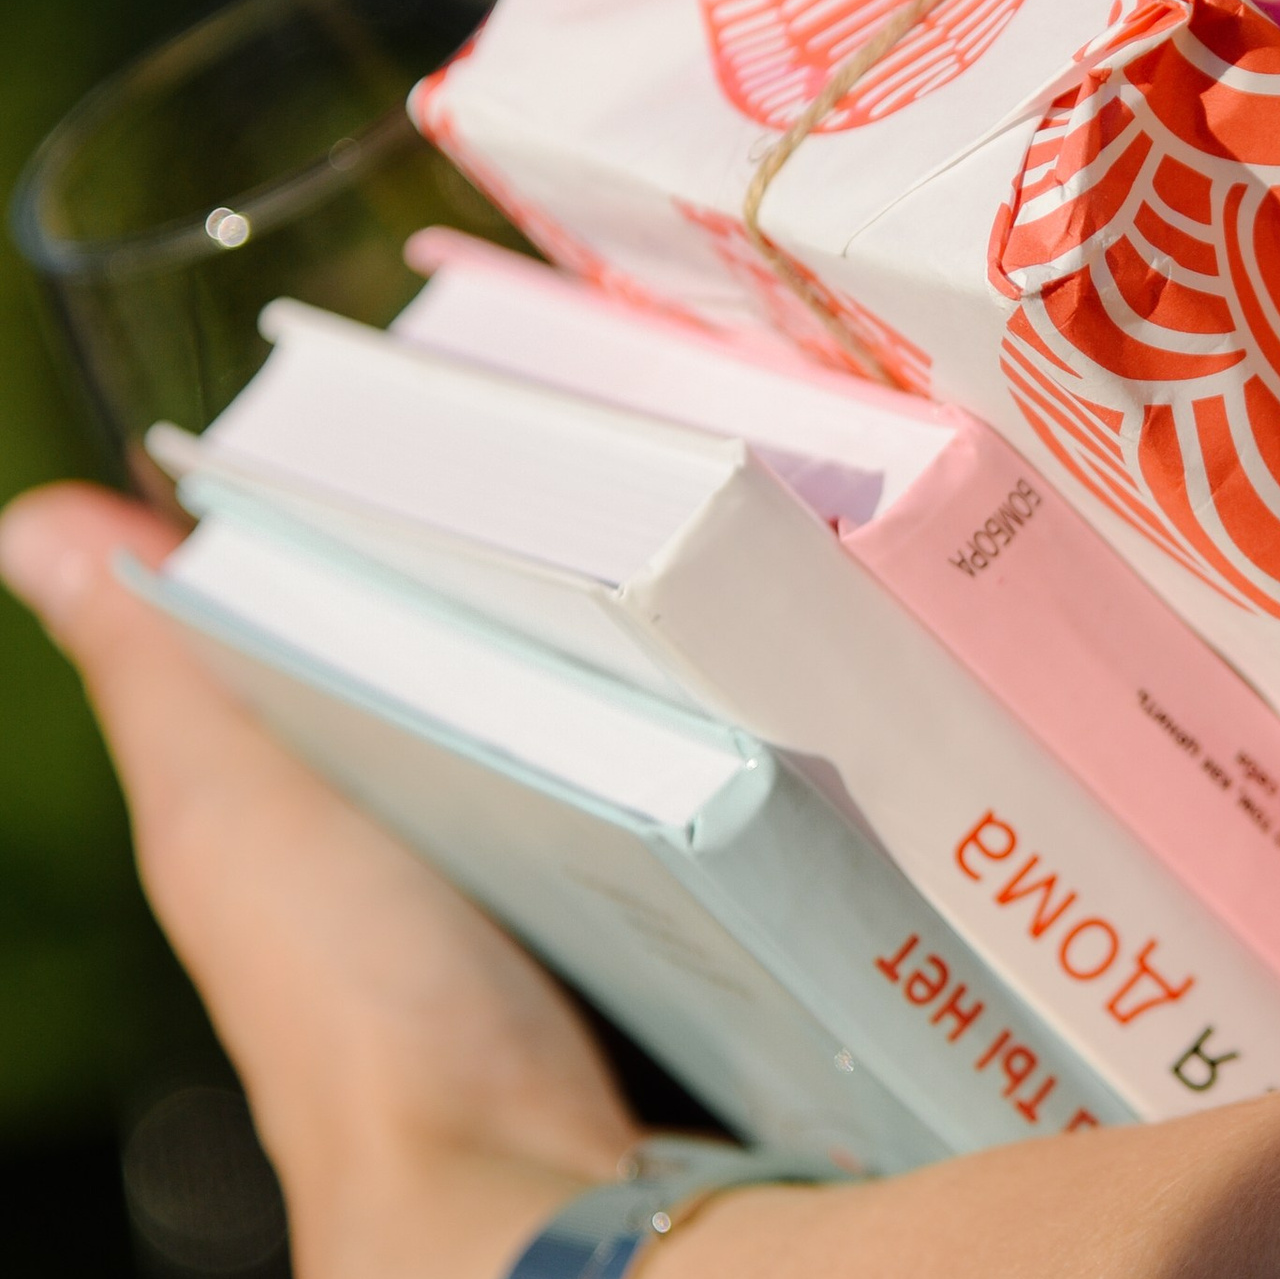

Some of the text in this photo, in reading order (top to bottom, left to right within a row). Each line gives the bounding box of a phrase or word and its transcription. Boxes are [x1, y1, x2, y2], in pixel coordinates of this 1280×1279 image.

[947, 478, 1041, 577] БОМБОРА
[952, 808, 1197, 1028] дома
[873, 931, 1057, 1124] ты нет
